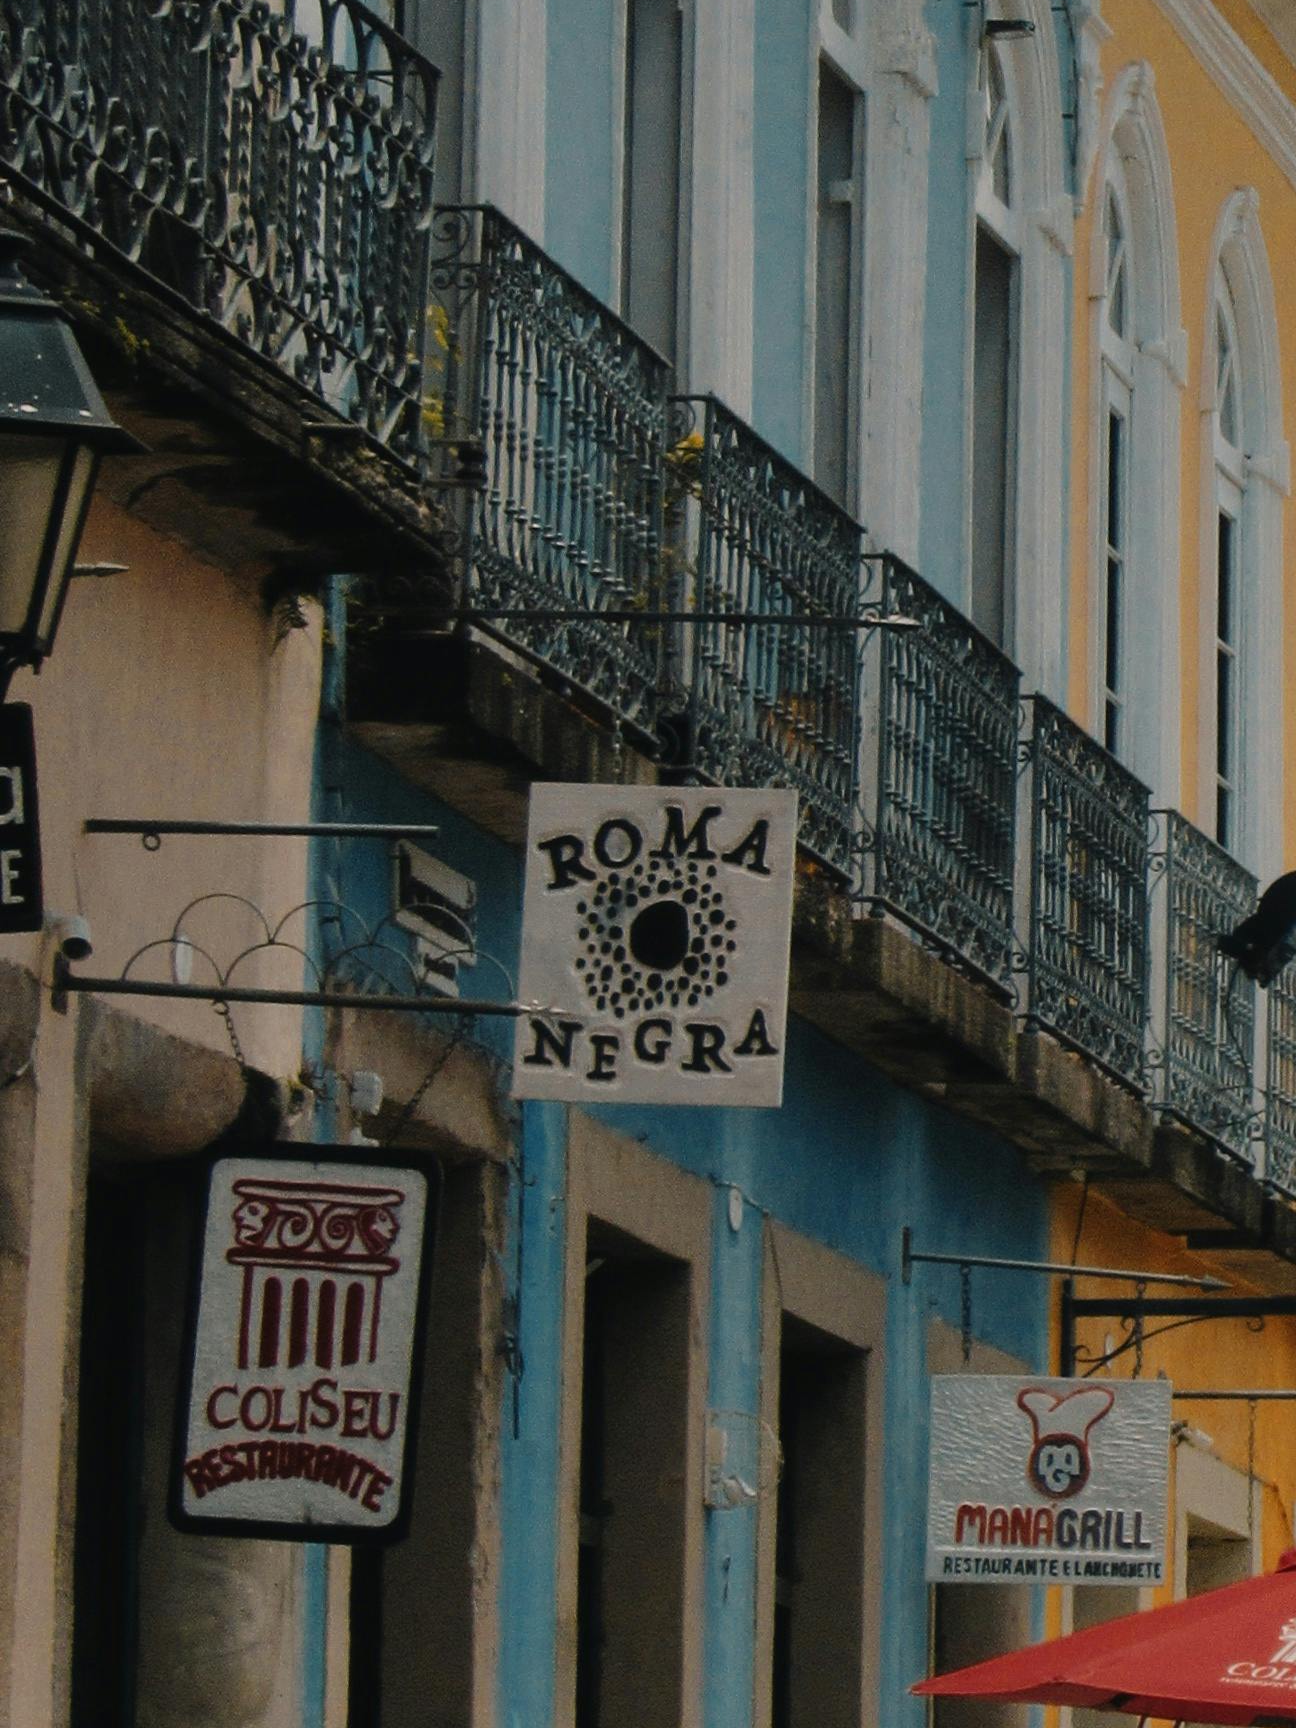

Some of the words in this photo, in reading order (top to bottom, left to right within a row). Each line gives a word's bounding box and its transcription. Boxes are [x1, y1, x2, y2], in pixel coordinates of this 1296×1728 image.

[537, 804, 771, 891] ROMA
[523, 1008, 779, 1082] NEGRA
[206, 1377, 401, 1441] COLISEU
[183, 1439, 394, 1513] RESTAURANTE
[943, 1556, 1058, 1576] RESTAURANTE
